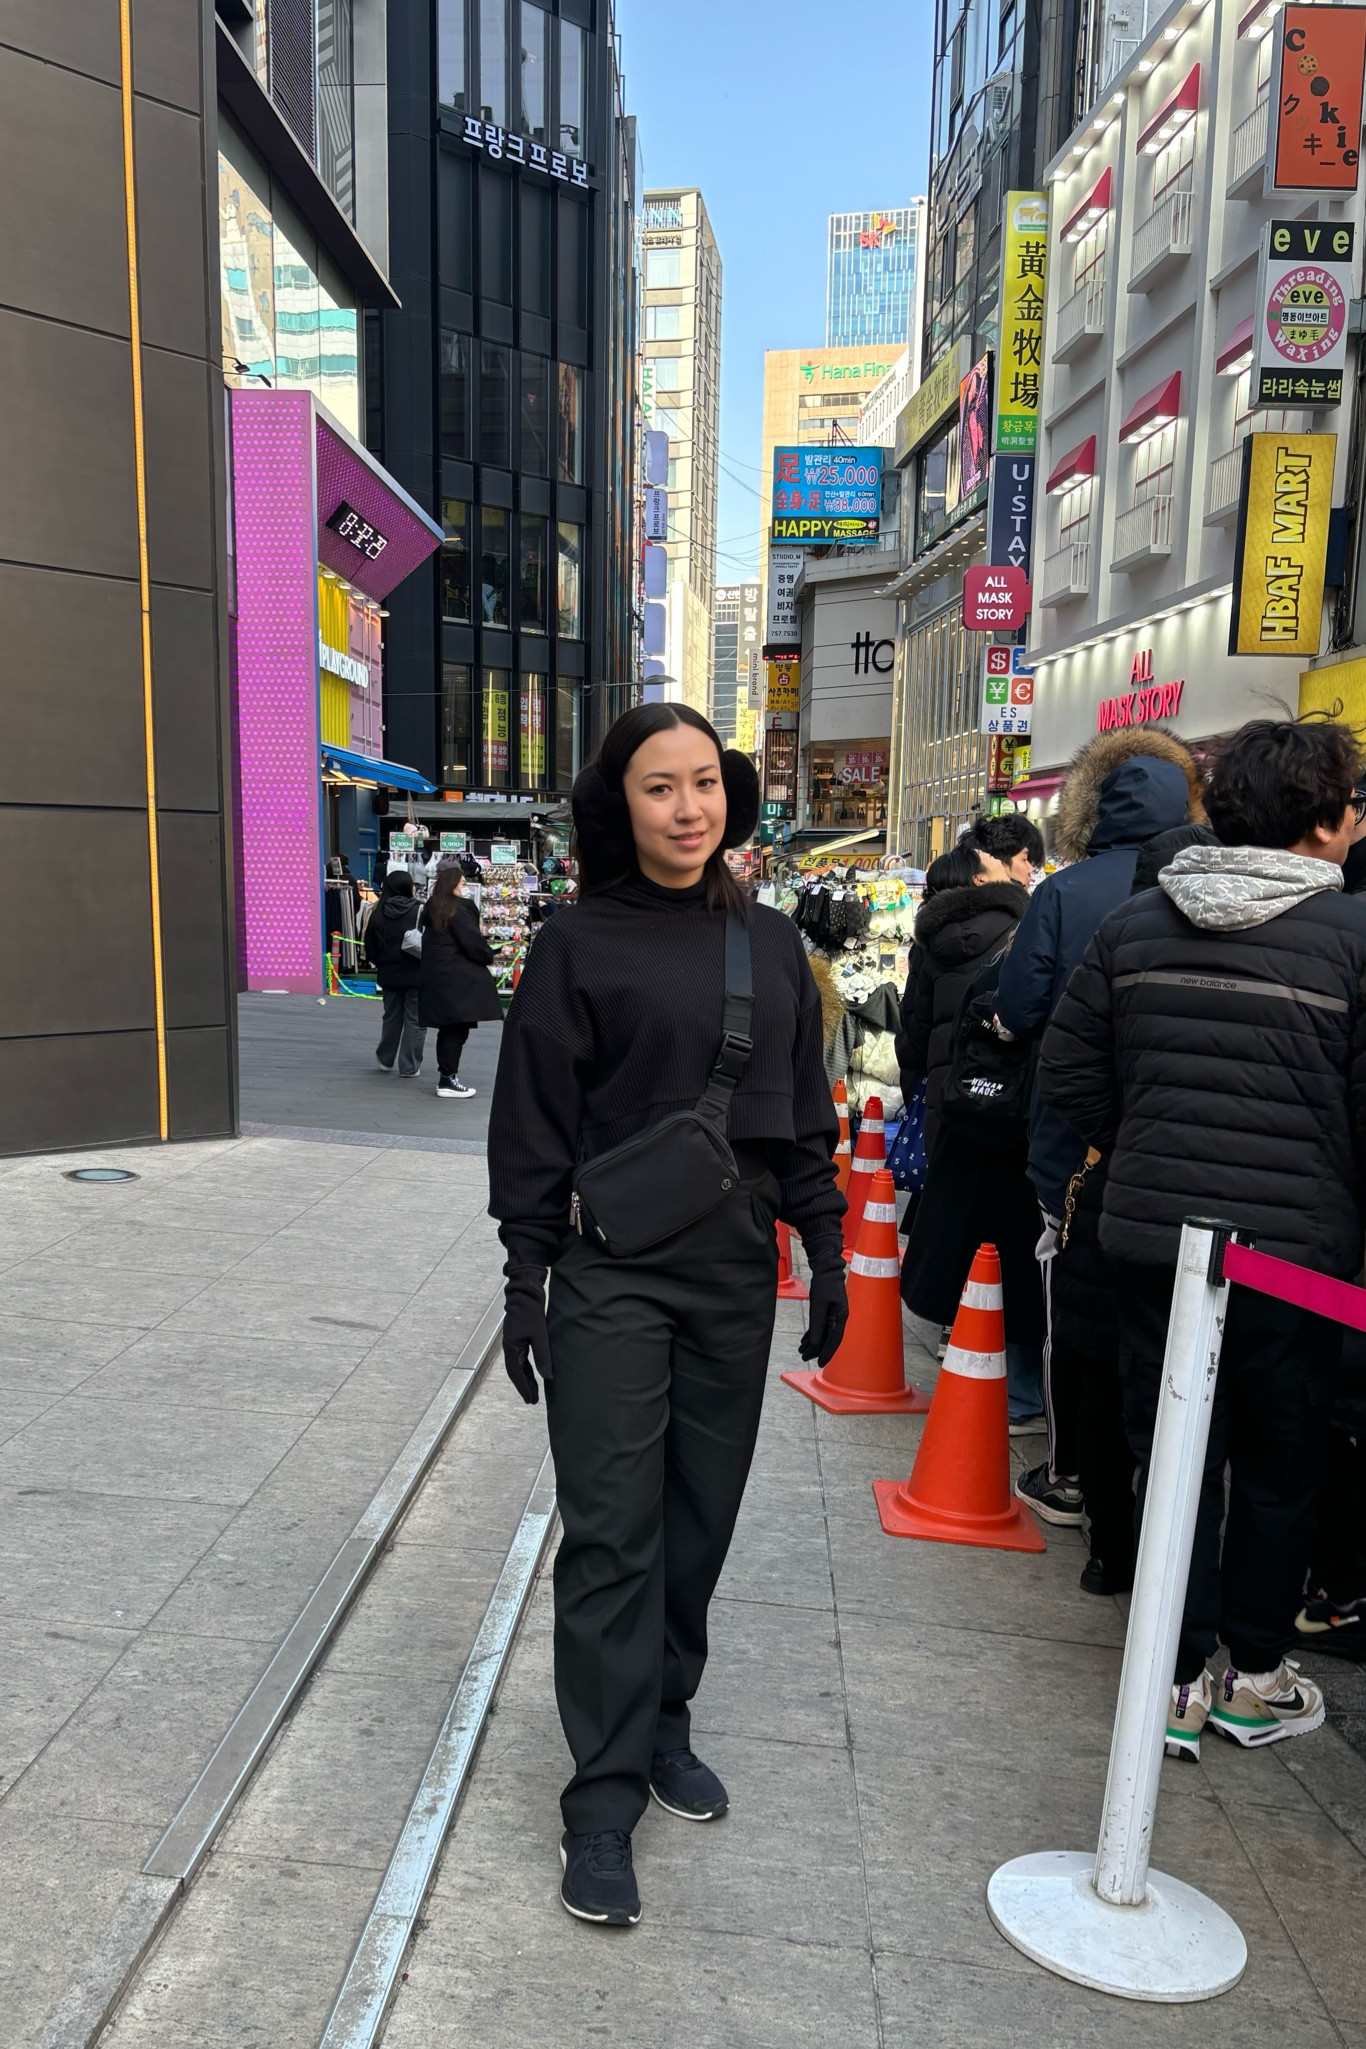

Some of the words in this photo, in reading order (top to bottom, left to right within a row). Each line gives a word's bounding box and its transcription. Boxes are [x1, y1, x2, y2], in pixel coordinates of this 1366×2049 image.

[860, 231, 881, 248] SK
[1290, 290, 1324, 303] eve
[1290, 329, 1320, 340] まゆ毛
[821, 364, 860, 379] Hana
[1262, 378, 1342, 399] 라라속눈썹
[1002, 420, 1038, 433] 황금목
[804, 454, 832, 465] 발관리
[833, 456, 856, 464] 40min
[776, 454, 801, 482] 足
[804, 466, 878, 486] ₩25,000
[1271, 446, 1312, 543] MART
[824, 498, 877, 513] ₩38,000
[774, 519, 833, 538] HAPPY
[777, 574, 794, 584] 증명
[984, 576, 1007, 588] ALL
[777, 588, 794, 598] 여권
[977, 592, 1013, 604] MASK
[1260, 555, 1303, 642] HBAF
[777, 601, 794, 611] 비자
[772, 615, 797, 625] 프로필
[976, 609, 1014, 620] STORY
[1129, 648, 1154, 684] ALL
[1097, 693, 1136, 732] MASK
[1137, 680, 1184, 723] STORY
[988, 720, 1028, 732] 상품권
[842, 766, 880, 783] SALE
[1180, 975, 1198, 985] new
[1199, 977, 1237, 990] balance
[971, 1078, 1003, 1090] HUMAN
